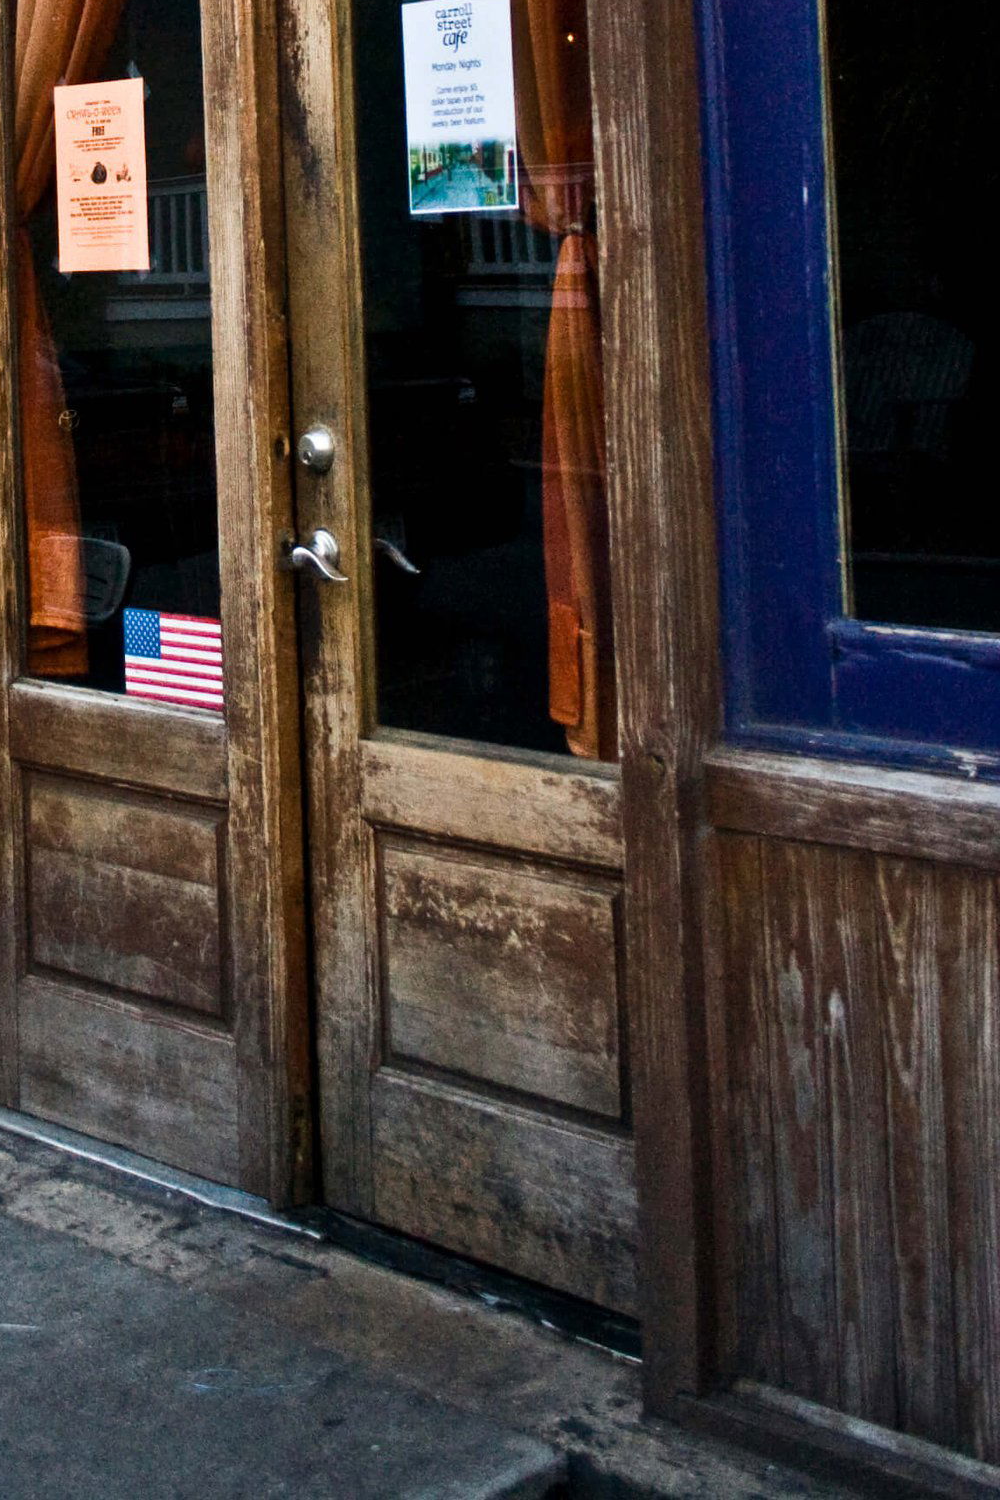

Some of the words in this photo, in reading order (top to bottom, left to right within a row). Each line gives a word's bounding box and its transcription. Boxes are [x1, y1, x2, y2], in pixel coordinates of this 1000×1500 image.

[435, 3, 472, 19] carroll
[437, 17, 472, 31] street
[459, 59, 481, 71] Nights
